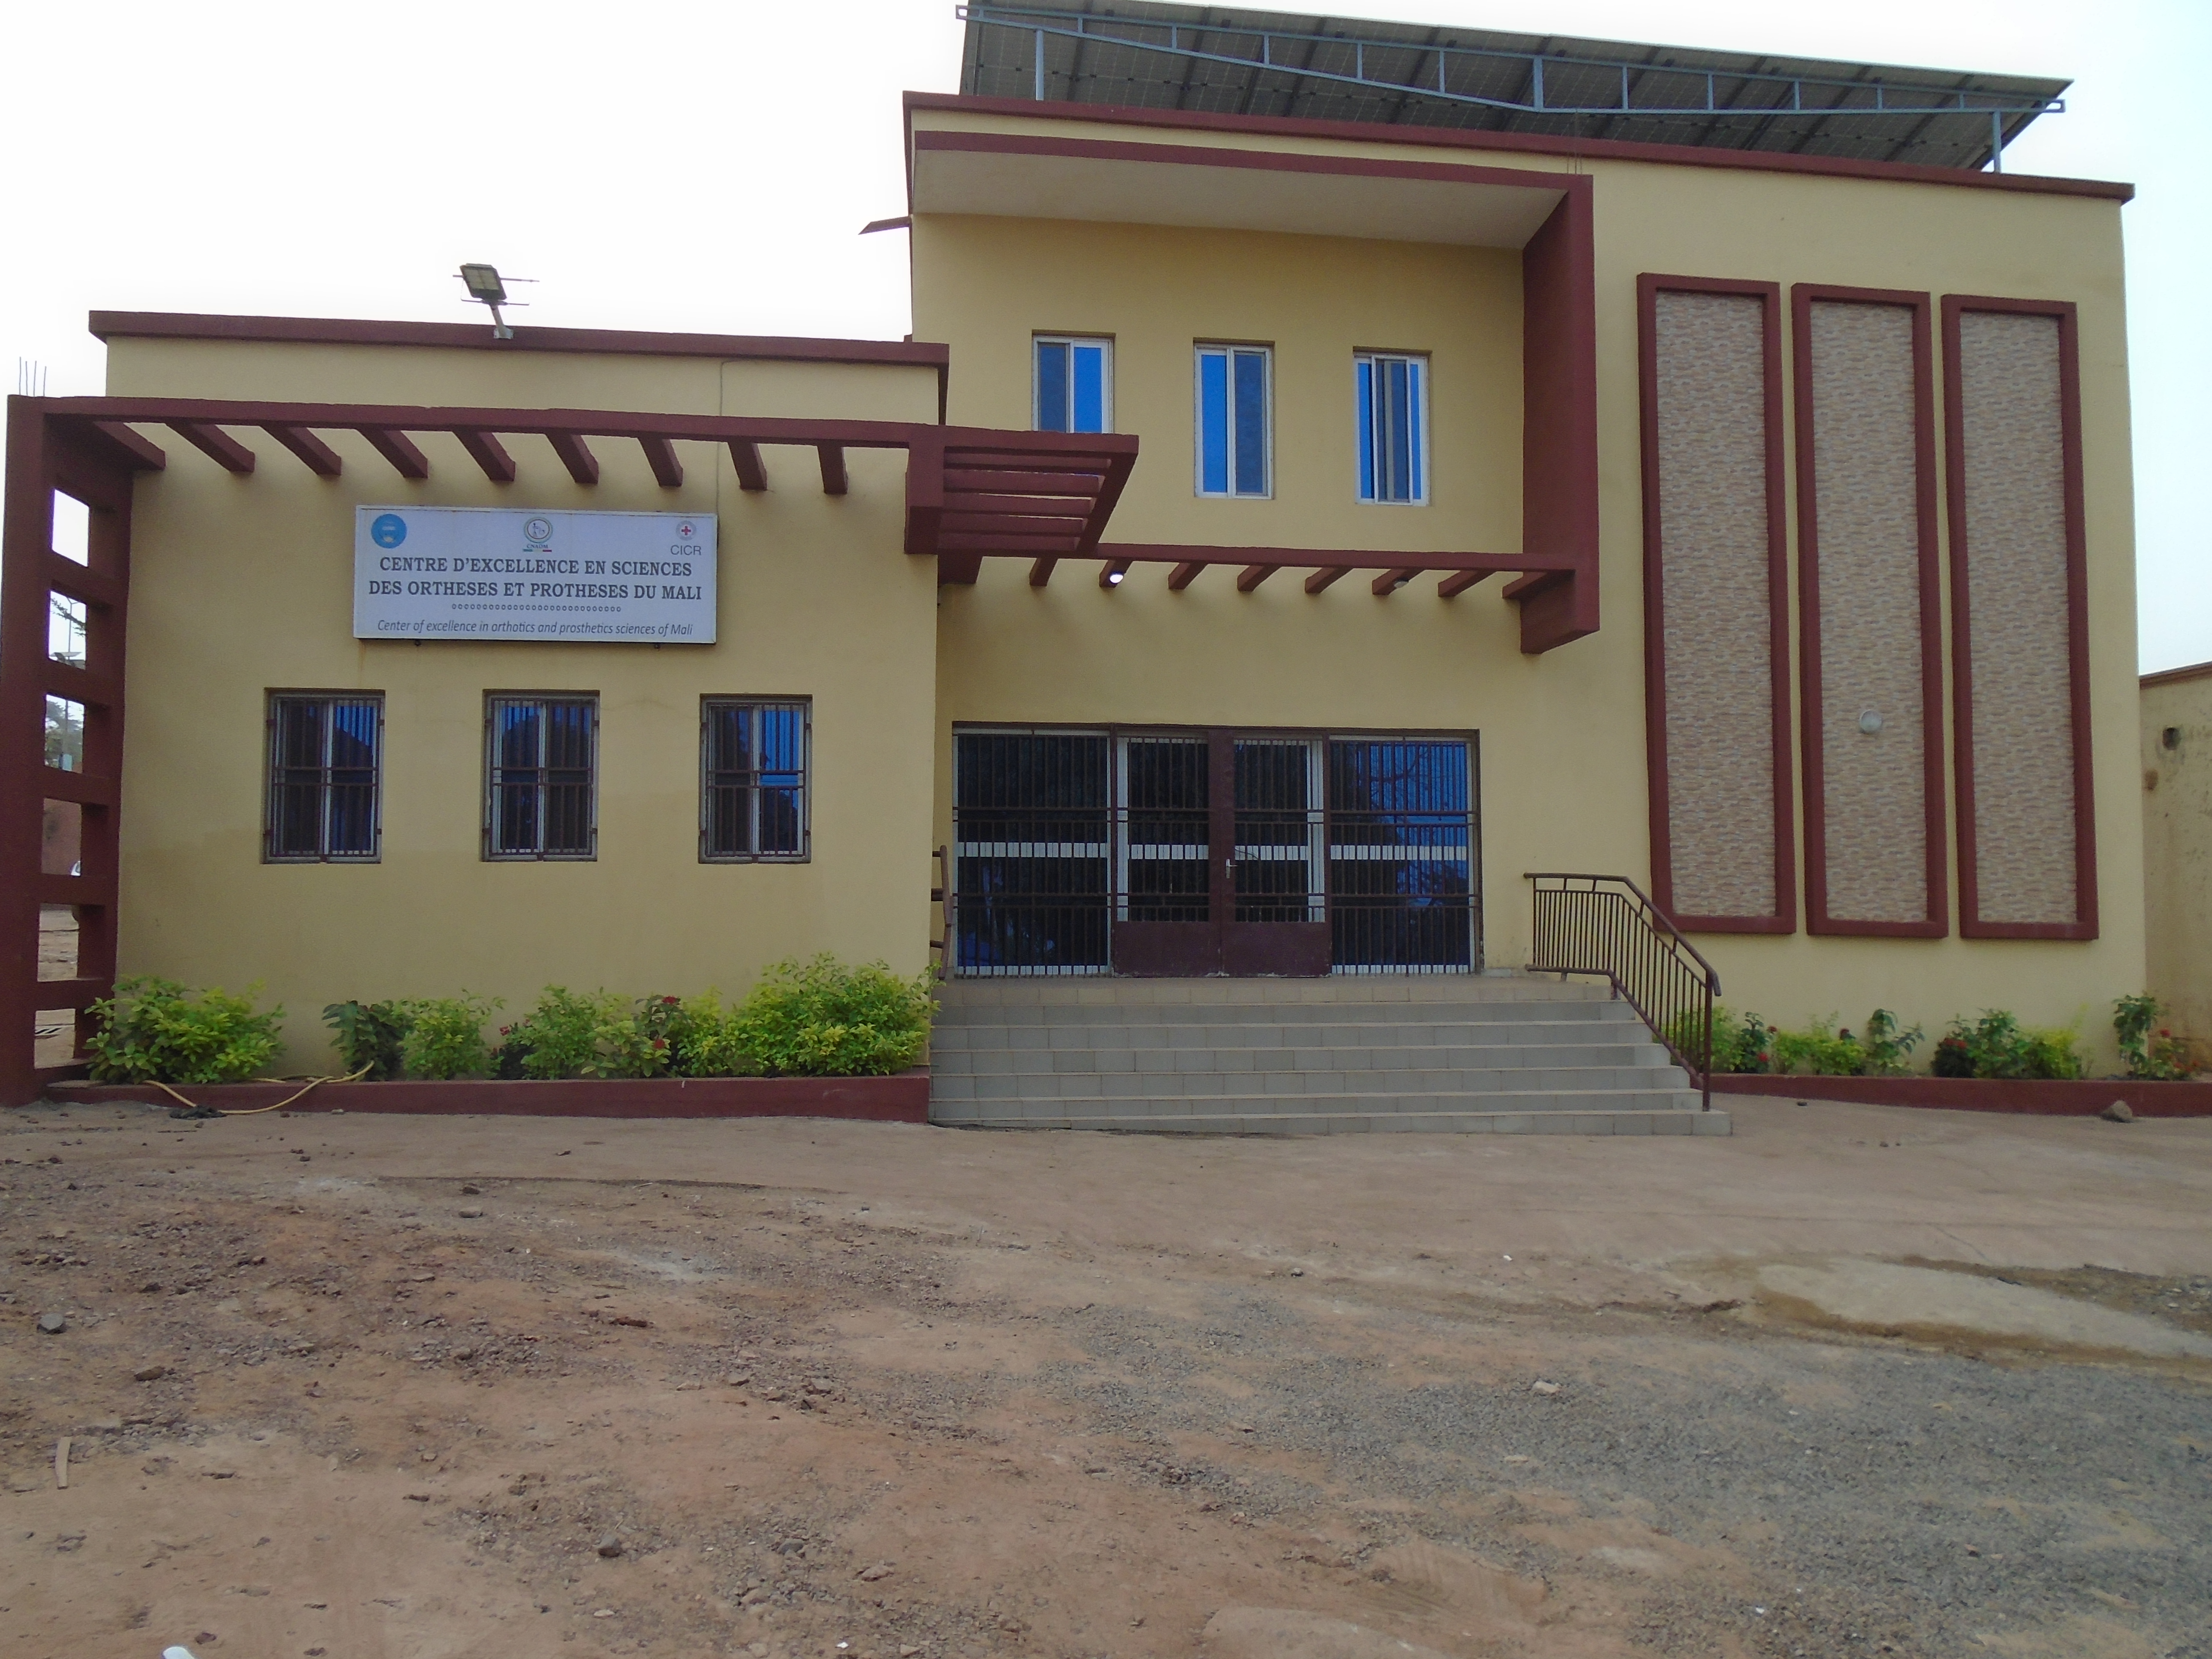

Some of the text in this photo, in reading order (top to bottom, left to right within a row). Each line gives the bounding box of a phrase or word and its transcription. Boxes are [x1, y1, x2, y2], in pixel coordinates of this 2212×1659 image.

[670, 544, 702, 556] CICR
[380, 556, 692, 577] CENTRE D'EXCELLENCE EN SCIENCES
[369, 580, 702, 600] DES ORTHESES ET PROTHESES DU MALI
[377, 619, 693, 637] Center of excellence in orthotics and prosthetics sciences of Mali
